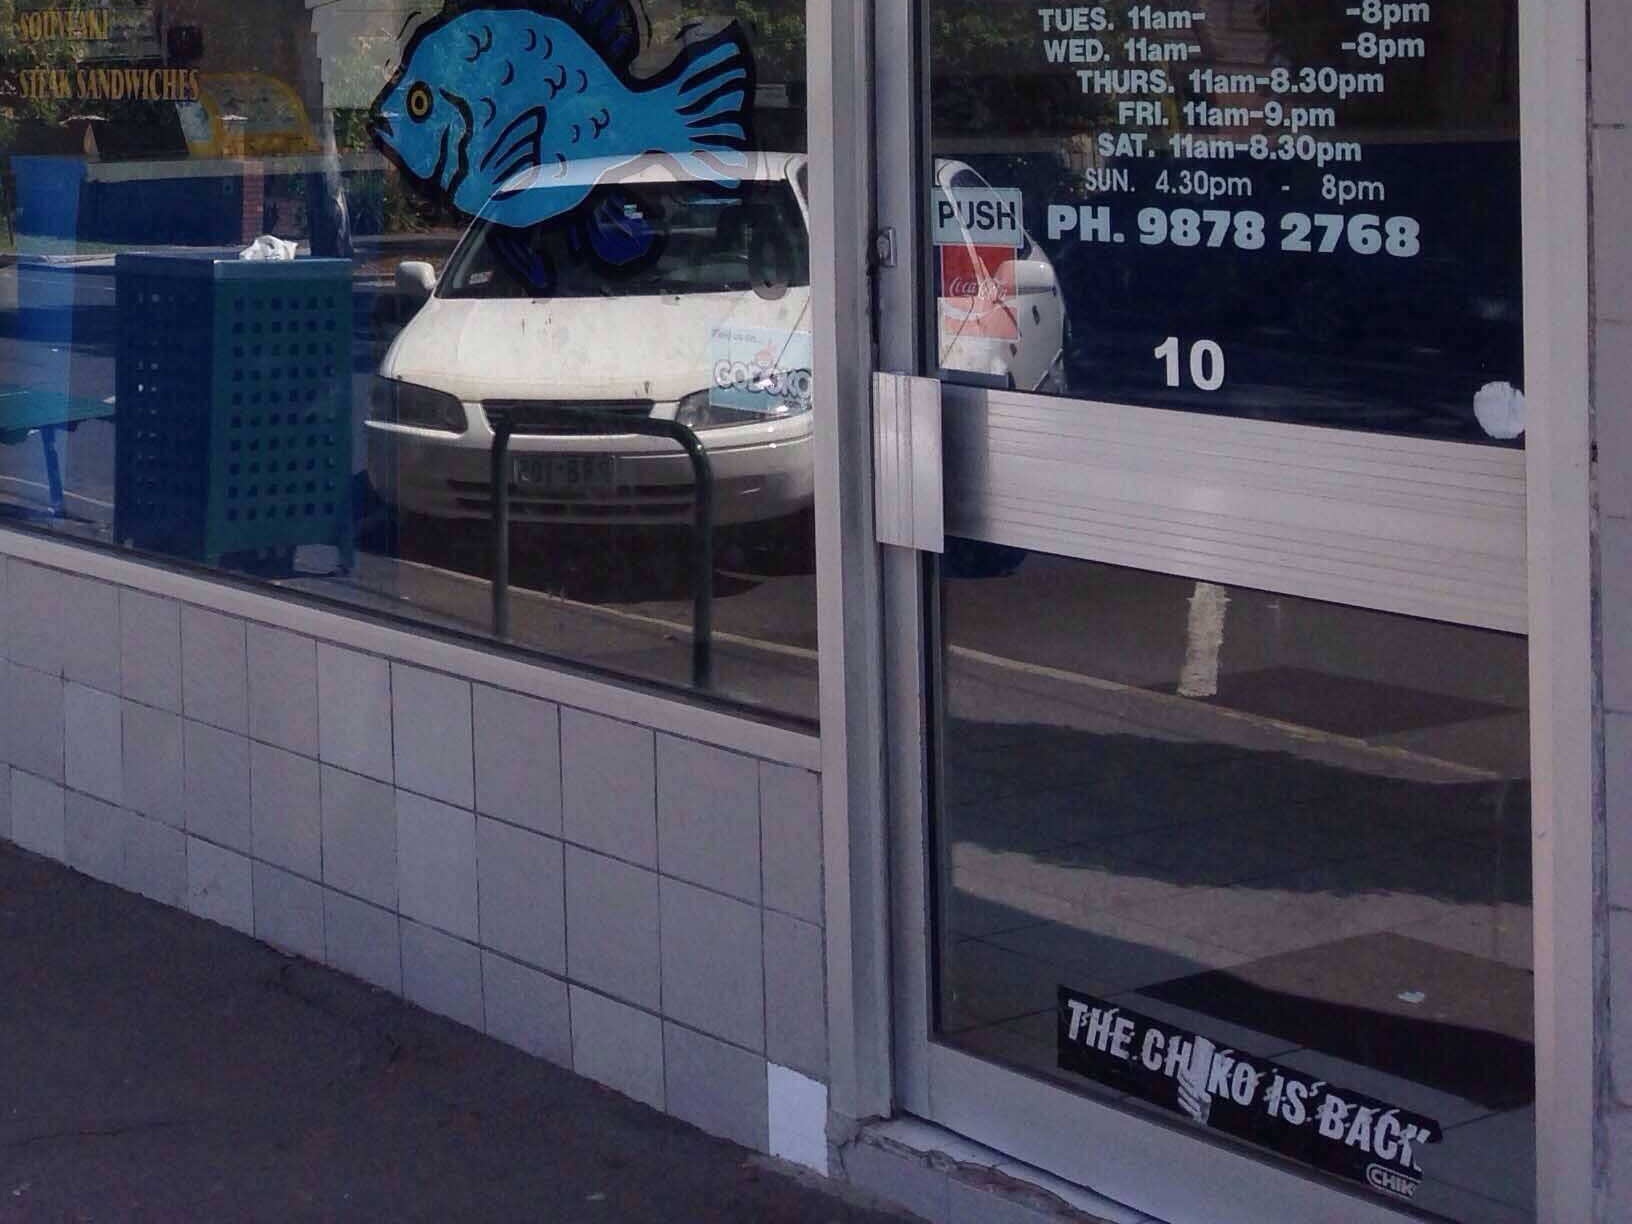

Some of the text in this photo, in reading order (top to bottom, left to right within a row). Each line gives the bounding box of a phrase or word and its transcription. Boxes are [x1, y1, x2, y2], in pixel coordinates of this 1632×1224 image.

[1038, 7, 1114, 32] TUES.
[1128, 5, 1205, 30] 11am-
[1044, 38, 1110, 63] WED.
[1124, 37, 1201, 62] 11am-
[77, 68, 200, 100] SANDWICHES
[1077, 67, 1384, 101] THURS. 11am-8.30pm
[1118, 102, 1169, 127] FRI.
[1098, 132, 1362, 167] SAT. 11am-8.30pm
[1085, 168, 1136, 193] SUN.
[1155, 170, 1252, 200] 4.30pm
[1321, 174, 1385, 205] 8pm
[938, 199, 1016, 231] PUSH
[1047, 205, 1421, 258] PH. 9878 2768
[1153, 335, 1226, 391] 10
[1068, 999, 1135, 1060] THE
[1265, 1069, 1308, 1125] IS
[1318, 1093, 1431, 1172] BACK
[1371, 1167, 1418, 1197] CHIK
